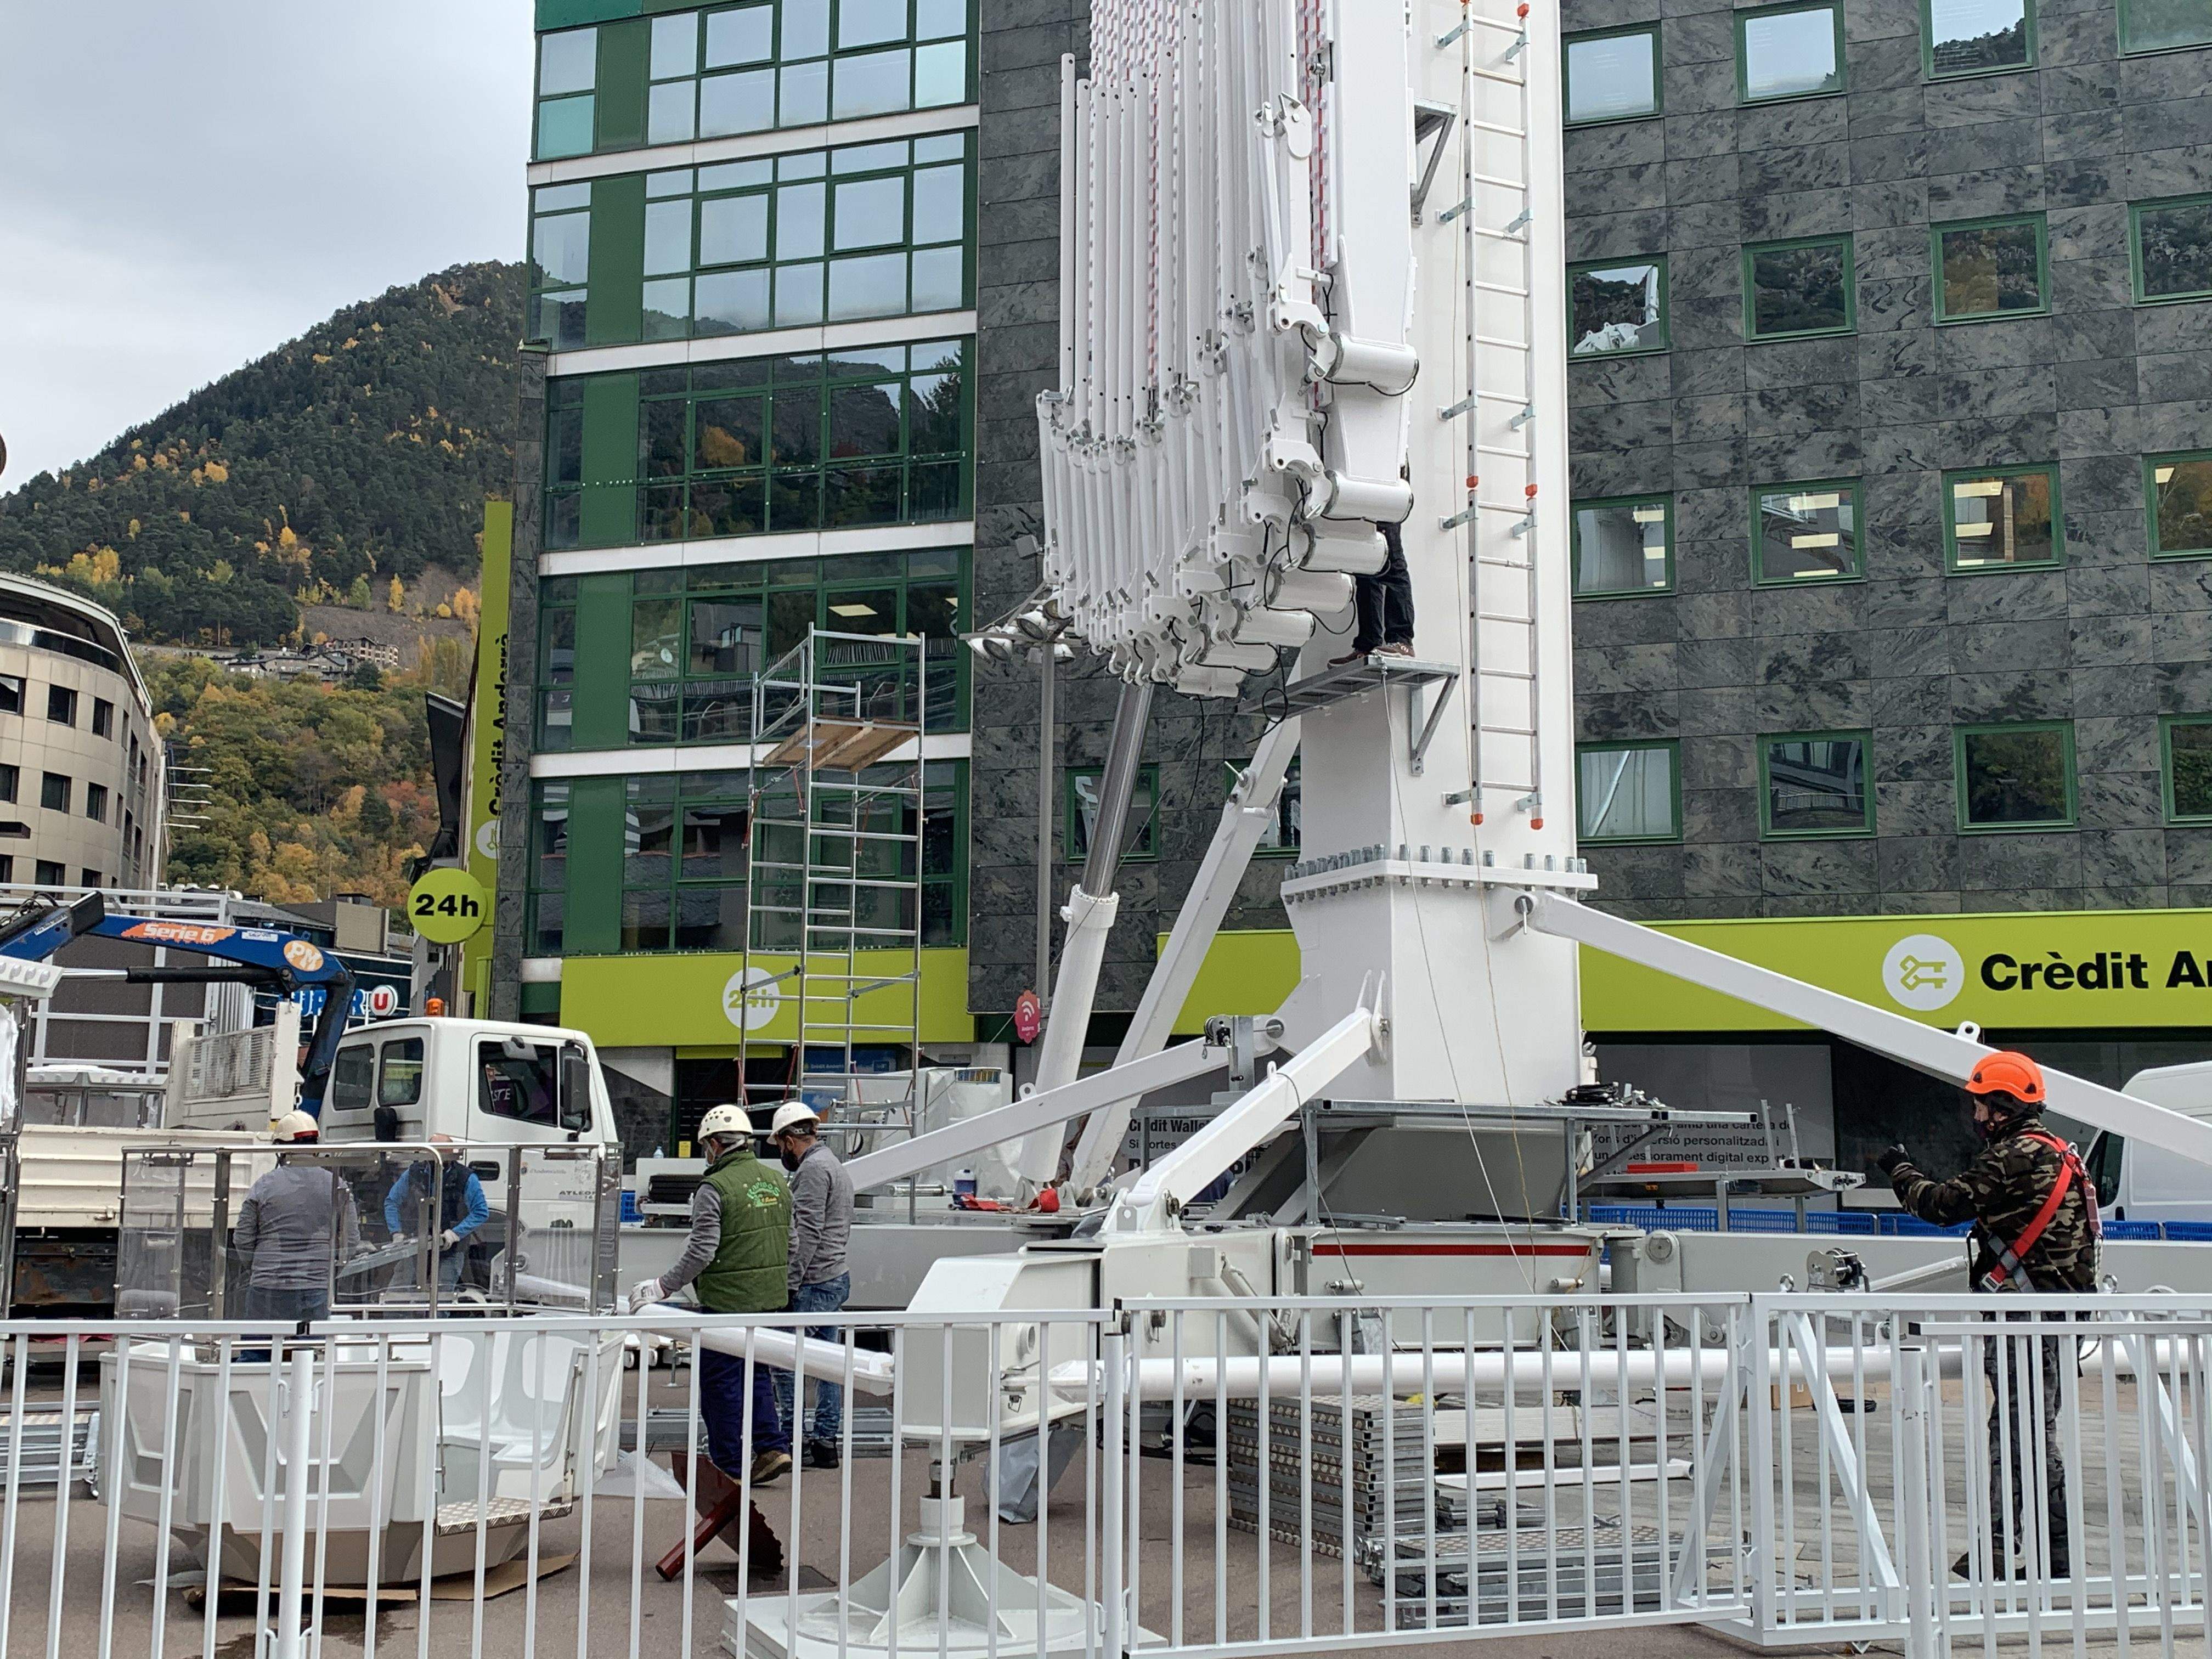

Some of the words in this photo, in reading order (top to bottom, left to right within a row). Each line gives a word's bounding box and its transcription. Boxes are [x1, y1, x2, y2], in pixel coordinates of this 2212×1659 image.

[415, 894, 478, 917] 24h
[144, 923, 198, 940] Serie
[200, 927, 216, 942] 6
[286, 941, 323, 971] PM
[1980, 952, 2149, 991] Crèdit
[2165, 951, 2212, 988] A
[279, 989, 364, 1017] UPR
[727, 989, 775, 1008] 24h
[1129, 1119, 1167, 1132] Crdit
[1170, 1120, 1210, 1132] Walle
[1733, 1121, 1775, 1130] cartea
[1129, 1139, 1139, 1149] Si
[1148, 1140, 1177, 1149] ortes
[1684, 1136, 1768, 1147] personalitzad
[1706, 1152, 1743, 1164] digital
[1747, 1154, 1786, 1165] exprt
